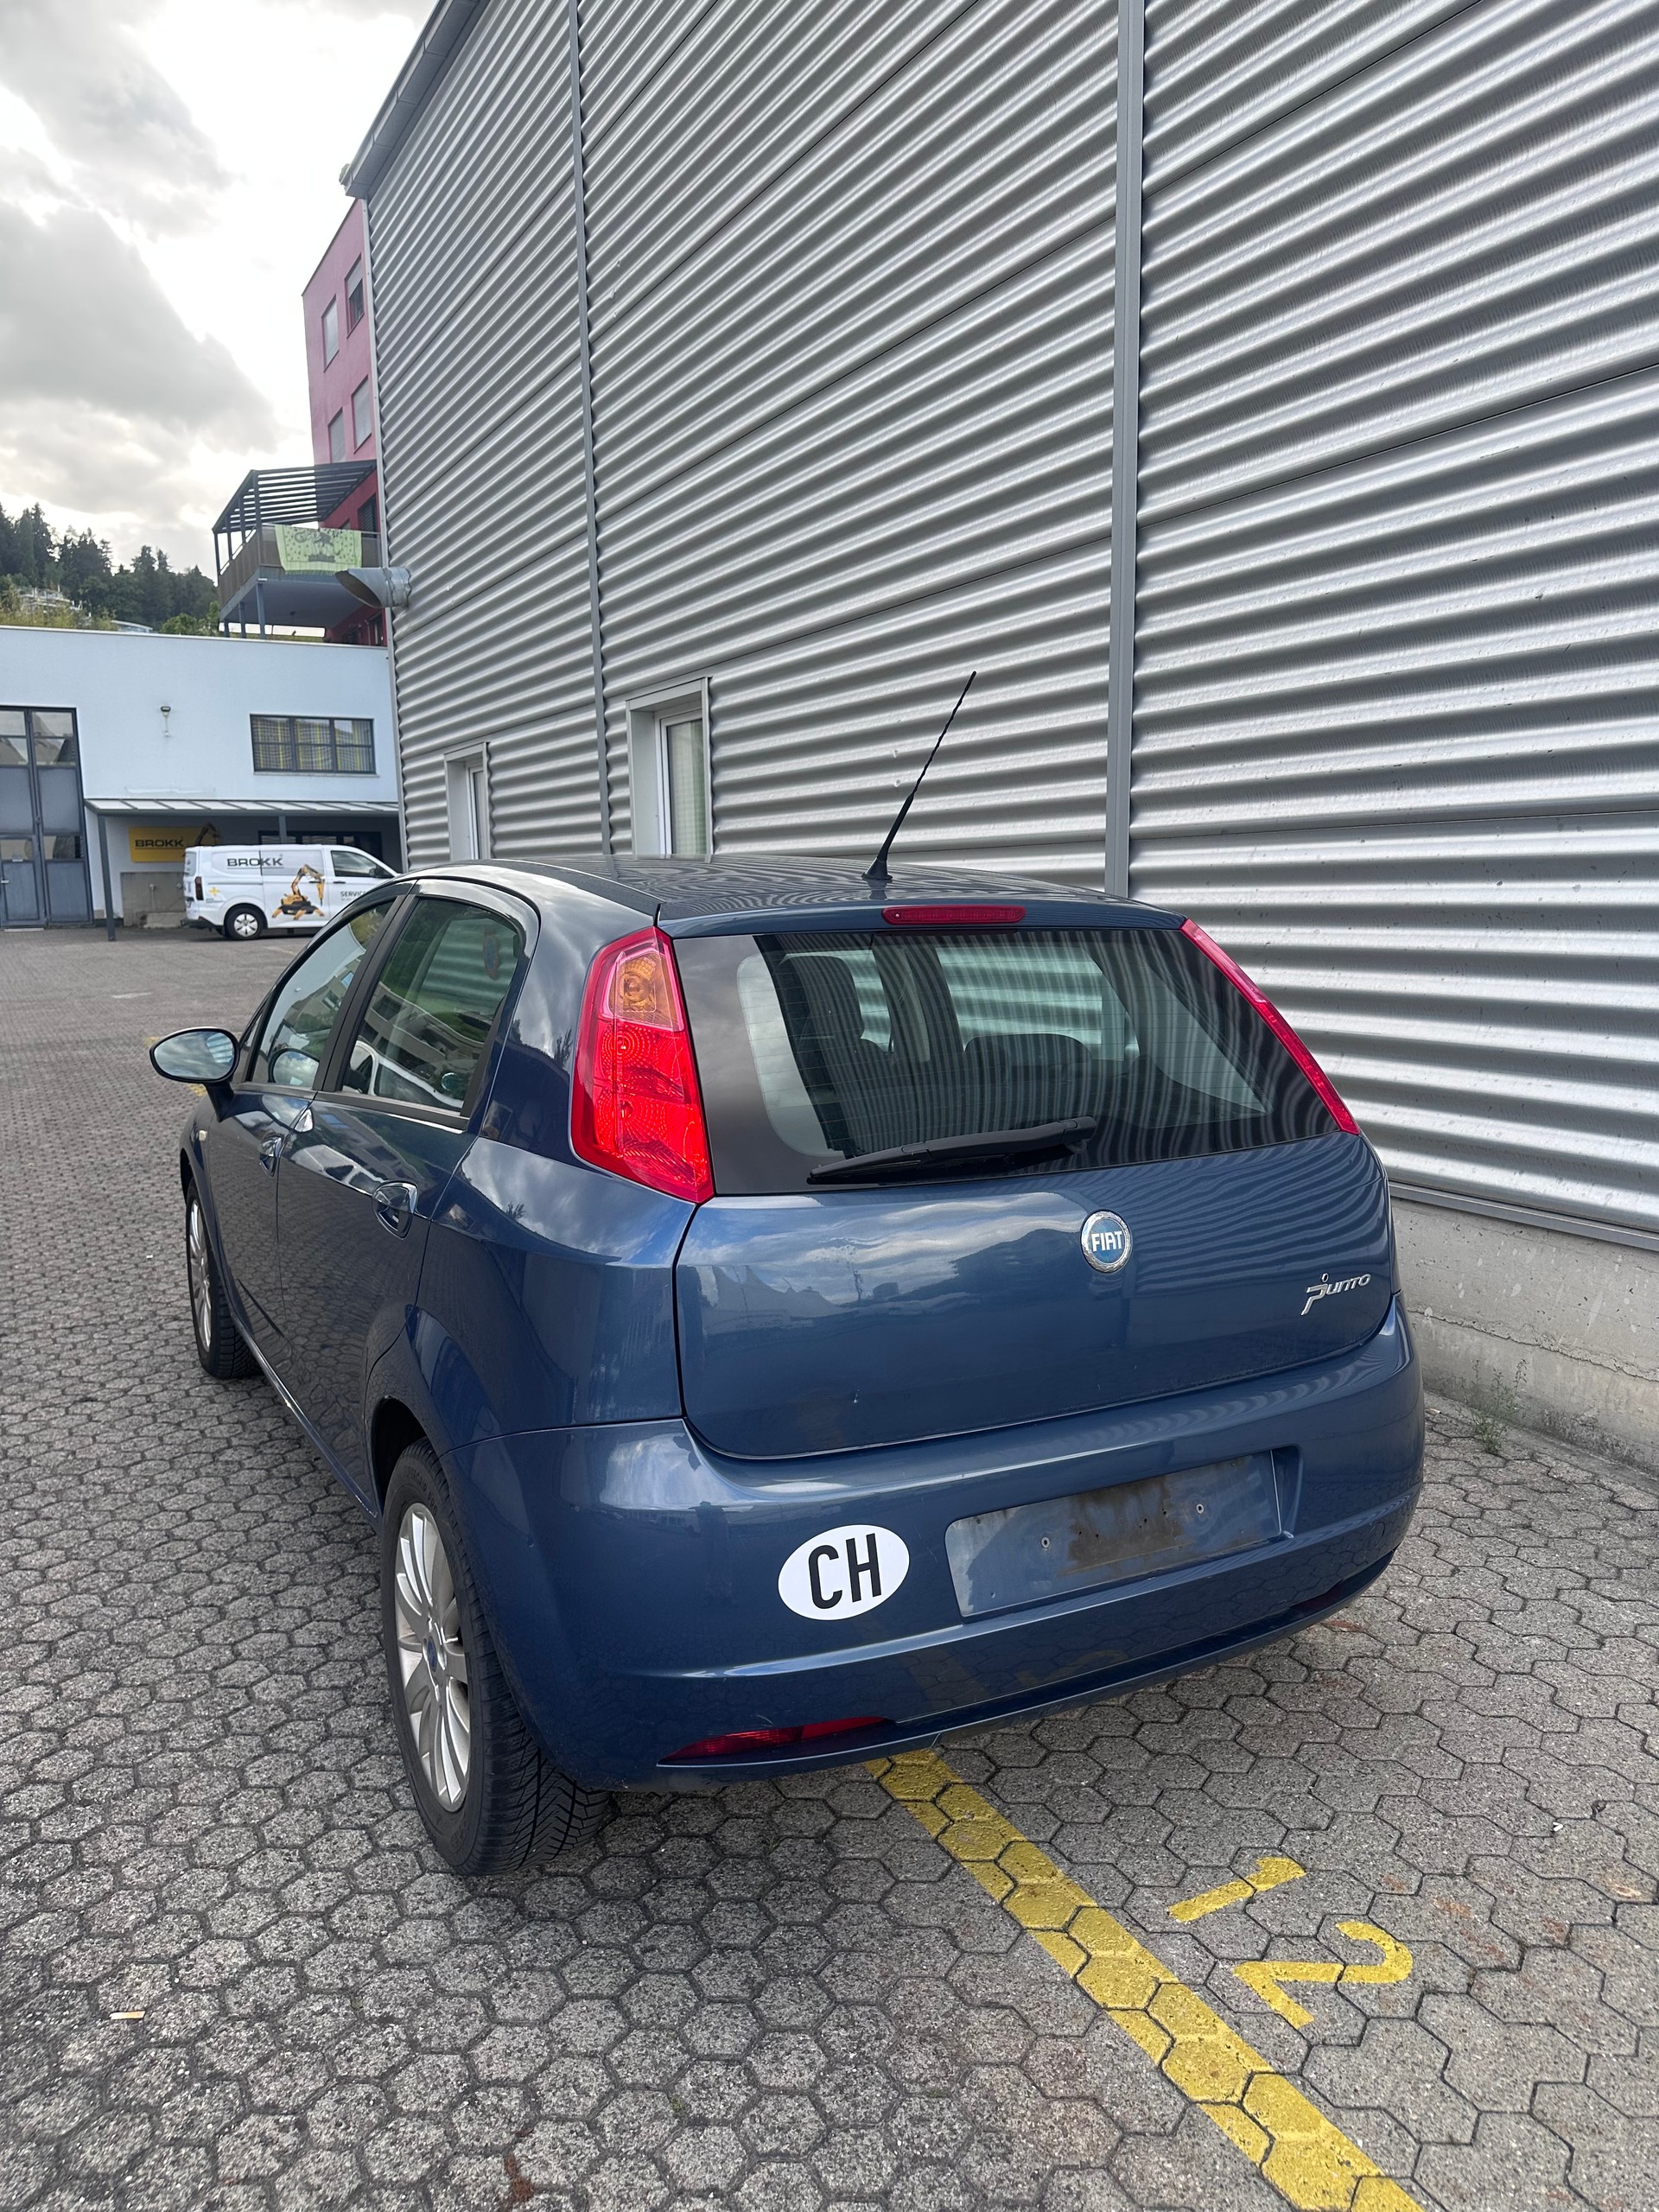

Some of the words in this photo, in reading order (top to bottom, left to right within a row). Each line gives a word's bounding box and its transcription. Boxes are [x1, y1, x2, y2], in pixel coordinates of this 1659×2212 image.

[135, 839, 184, 848] BROKK
[227, 858, 283, 867] BROKK
[1091, 1230, 1123, 1252] FIAT
[808, 1533, 882, 1611] CH
